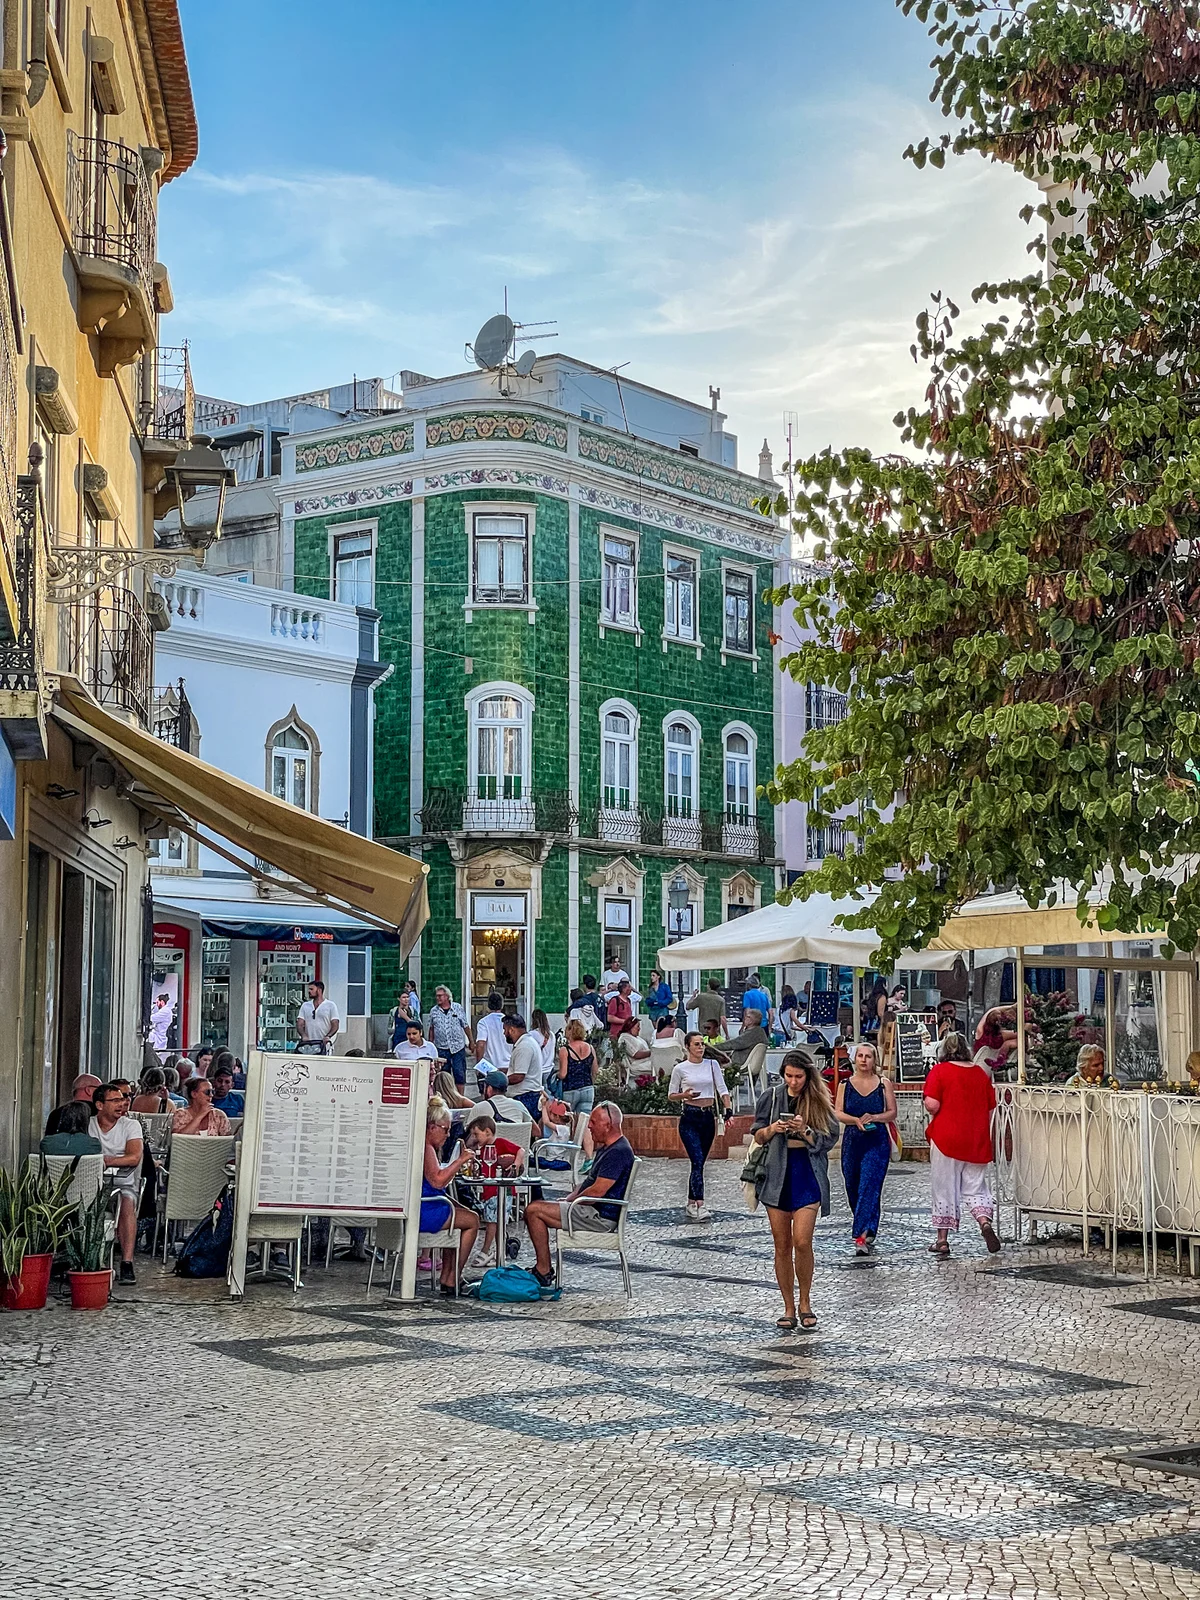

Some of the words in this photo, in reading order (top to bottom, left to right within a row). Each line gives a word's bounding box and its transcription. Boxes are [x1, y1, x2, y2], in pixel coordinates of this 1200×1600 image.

[315, 1075, 347, 1083] Restaurante
[352, 1076, 374, 1084] Pizzeria
[331, 1084, 357, 1093] MENU
